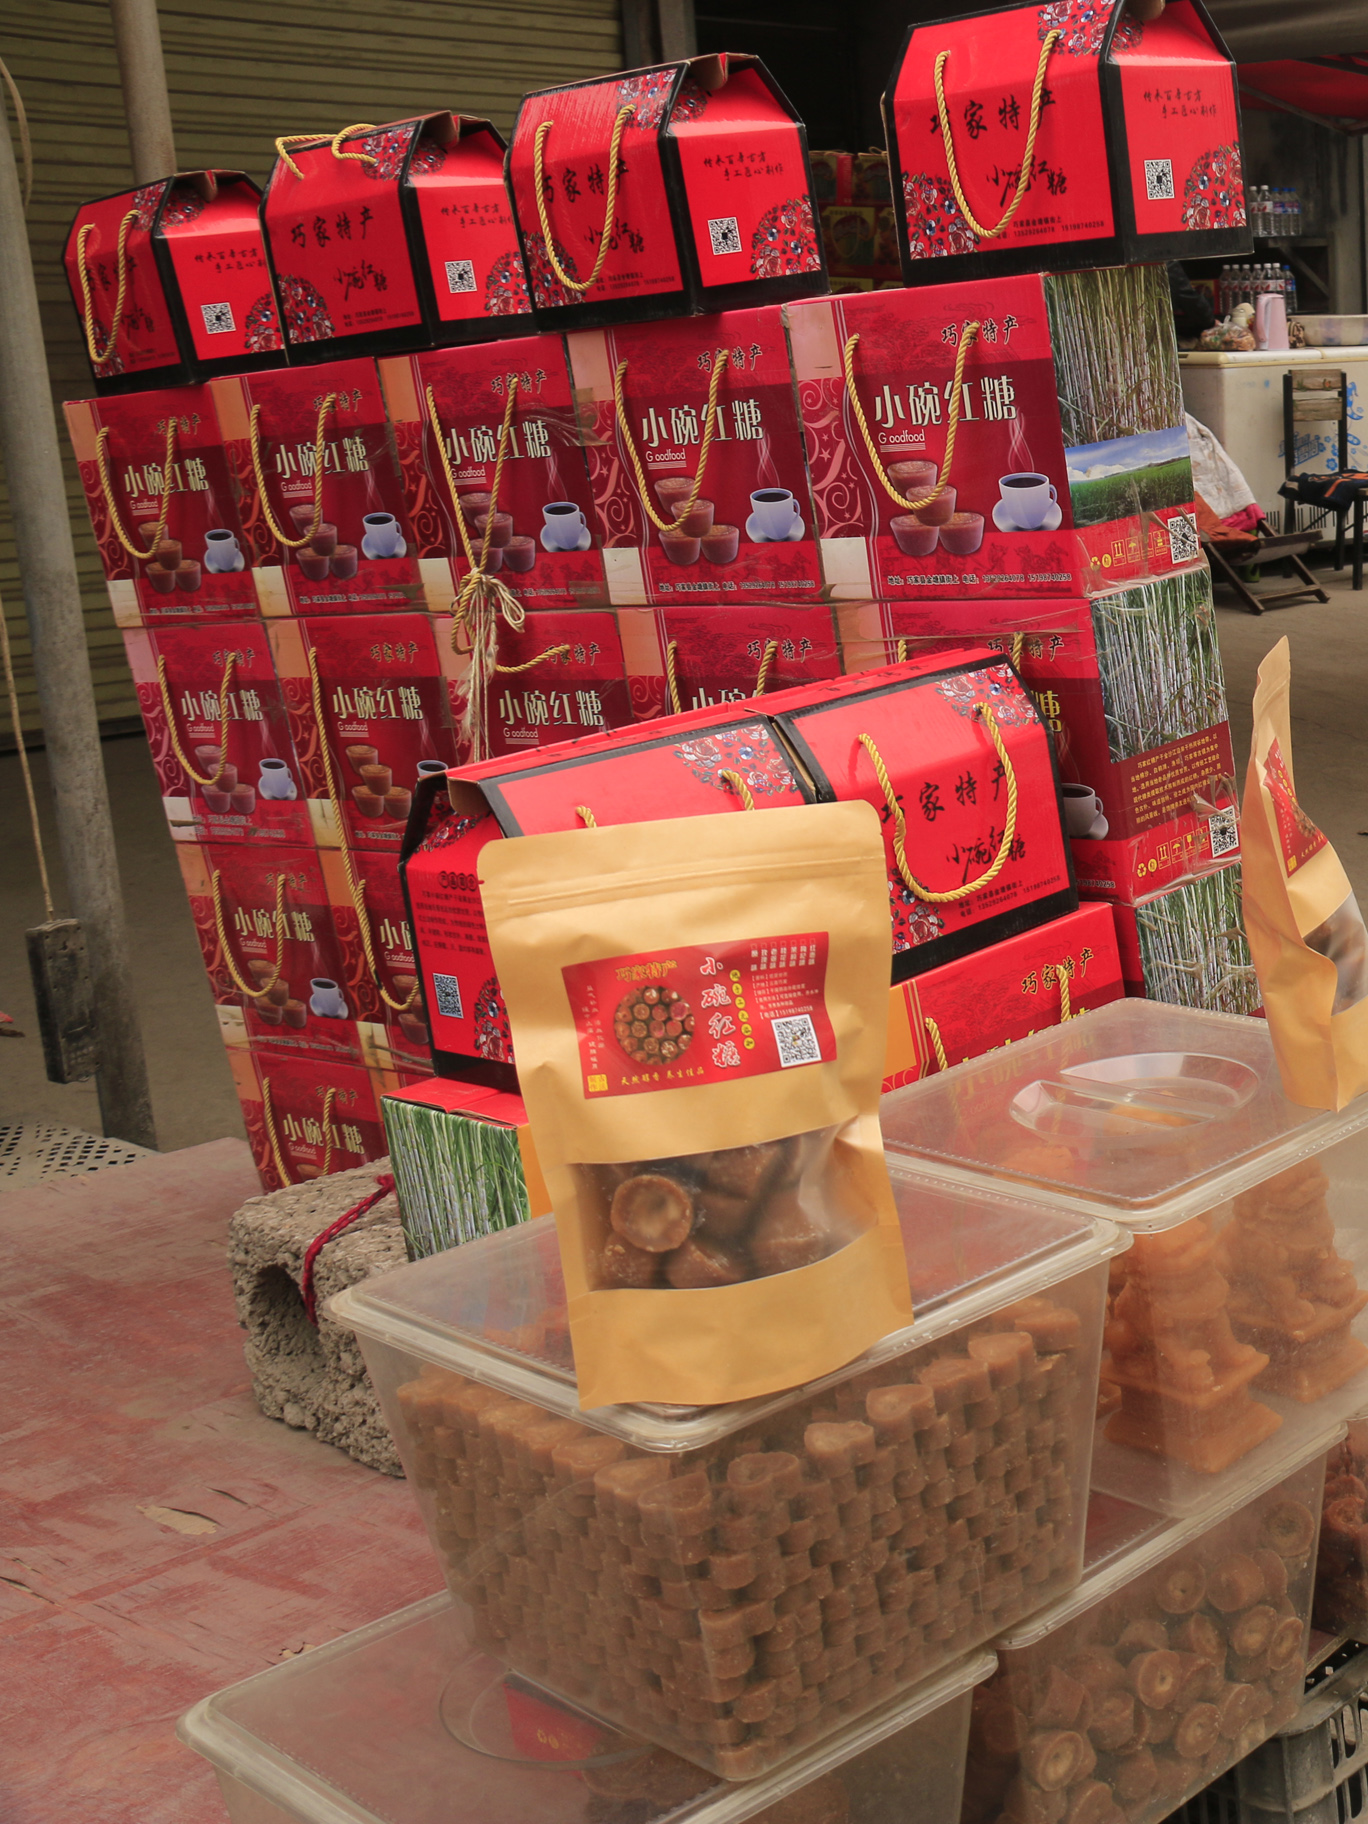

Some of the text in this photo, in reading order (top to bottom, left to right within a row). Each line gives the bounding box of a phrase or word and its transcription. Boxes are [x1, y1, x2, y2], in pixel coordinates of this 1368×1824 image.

[291, 205, 374, 249] 巧家特产
[641, 398, 765, 449] 小碗红糖
[874, 374, 1018, 432] 小碗红糖
[275, 436, 370, 479] 小碗红糖
[445, 418, 552, 466] 小碗红糖
[181, 689, 264, 722] 小碗红糖
[332, 685, 424, 721] 小碗红糖
[499, 689, 605, 728] 小碗红糖
[881, 759, 1007, 824] 巧家特产
[614, 959, 678, 983] 巧家特产
[1020, 946, 1094, 995] 巧家特产
[699, 956, 742, 1069] 小碗红糖
